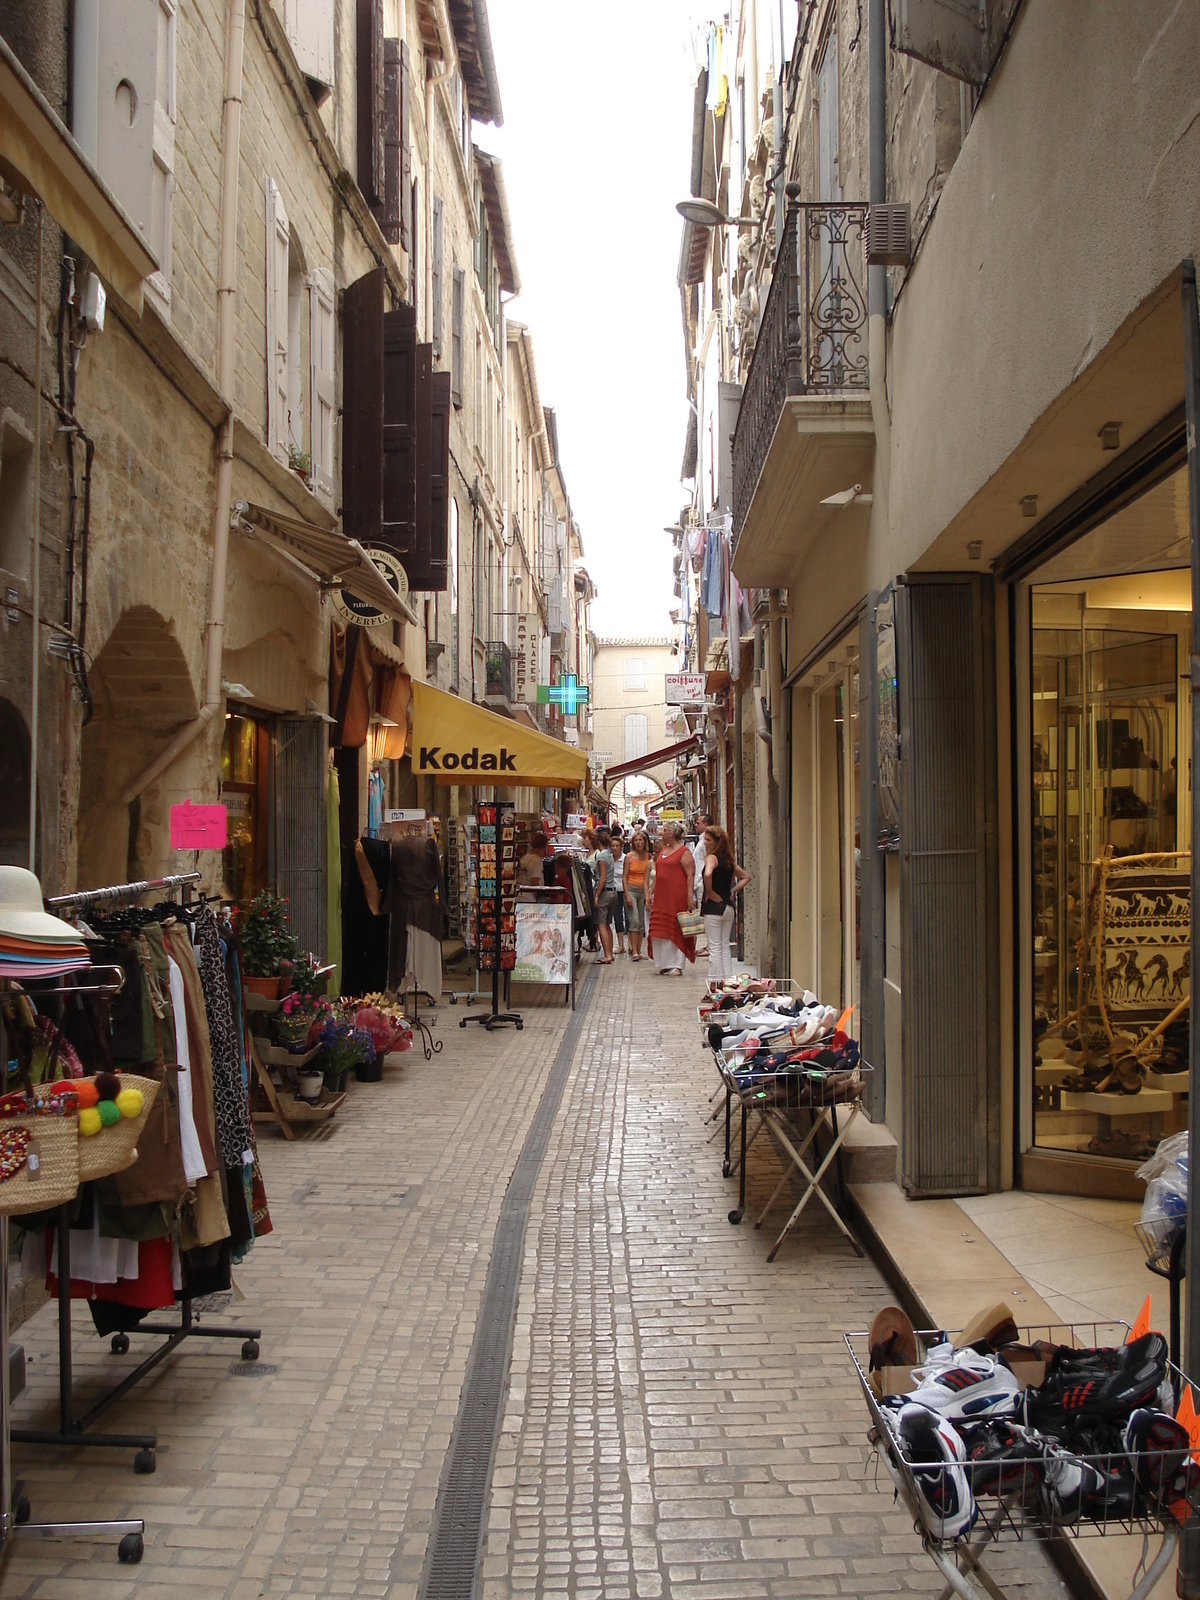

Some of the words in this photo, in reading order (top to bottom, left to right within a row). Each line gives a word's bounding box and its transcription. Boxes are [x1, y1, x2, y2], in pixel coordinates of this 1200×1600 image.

[380, 553, 398, 568] MONDE
[397, 567, 406, 592] ENTIER
[340, 606, 391, 626] INTERFLO
[517, 615, 526, 701] PATISSERIE
[667, 675, 703, 685] coiffure
[419, 747, 517, 771] Kodak
